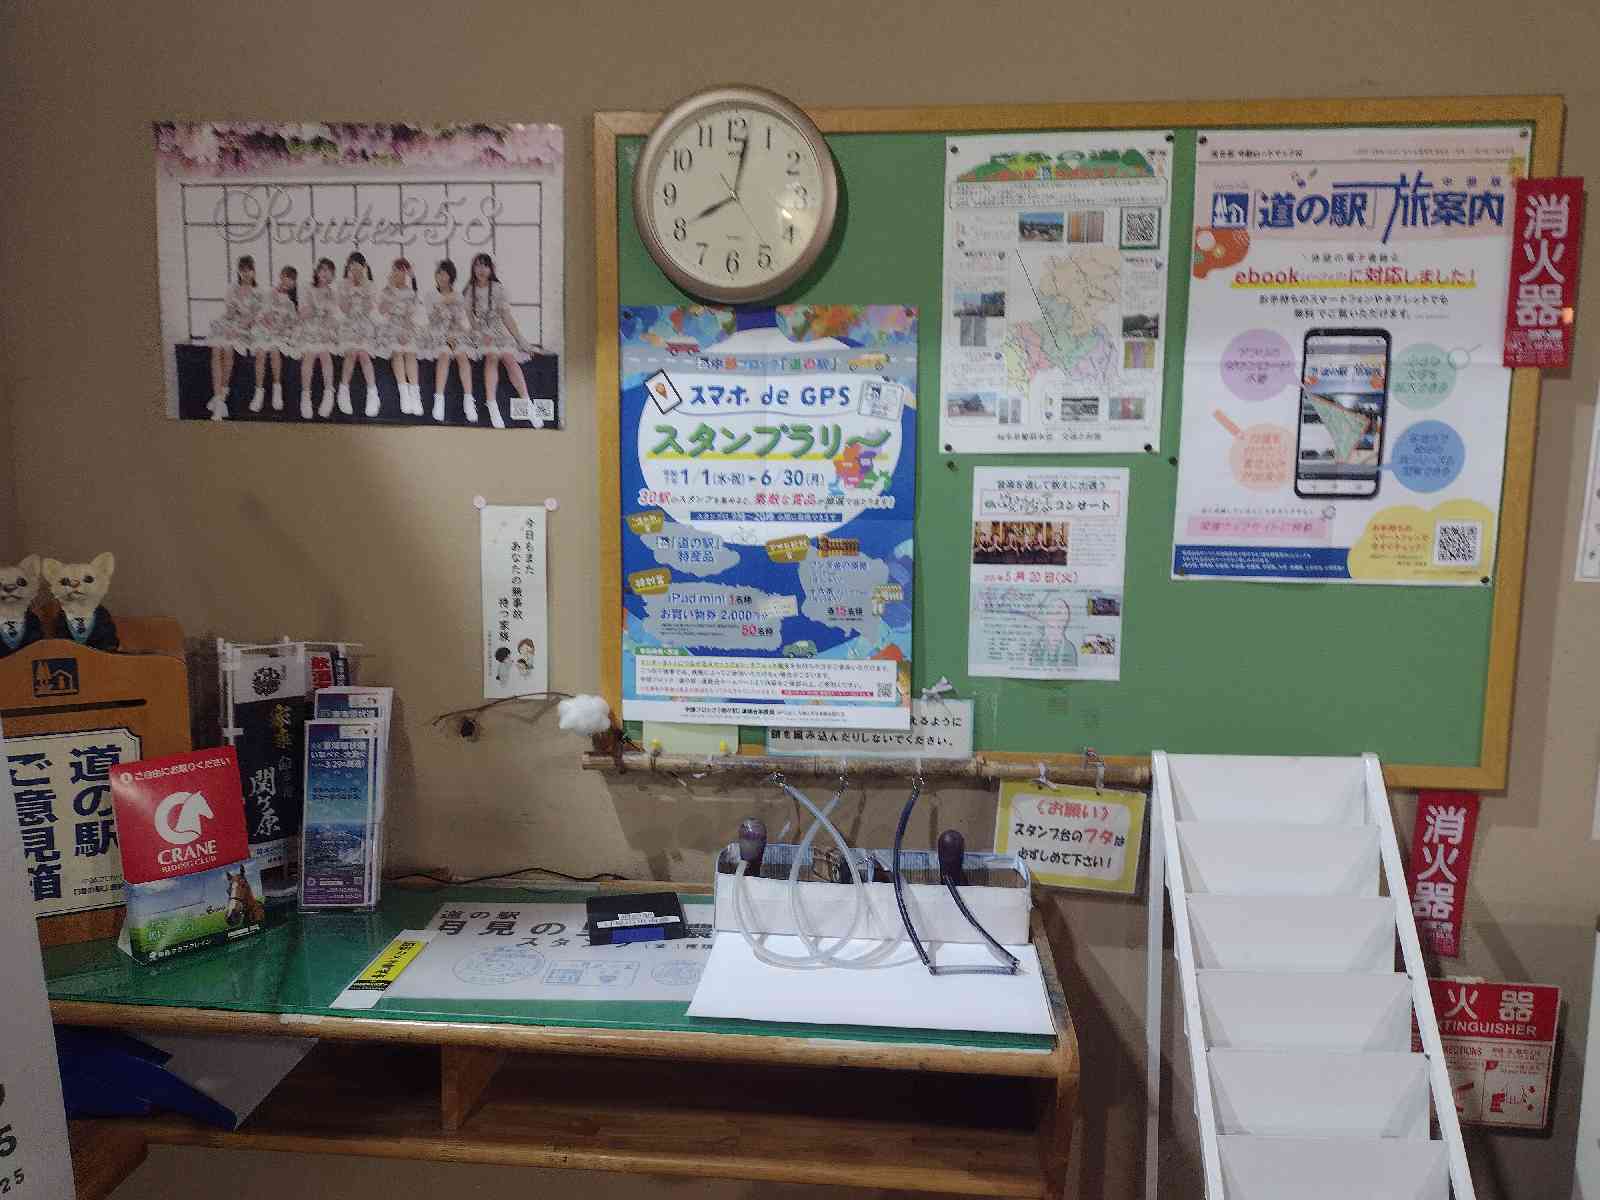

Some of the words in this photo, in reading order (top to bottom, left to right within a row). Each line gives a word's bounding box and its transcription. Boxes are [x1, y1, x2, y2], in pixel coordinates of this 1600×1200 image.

[699, 124, 712, 149] 11
[728, 117, 747, 143] 12
[766, 126, 772, 150] 1
[673, 148, 693, 173] 10
[786, 151, 801, 177] 2
[663, 182, 677, 207] 9
[1259, 191, 1369, 229] 道の駅
[673, 217, 687, 242] 8
[783, 223, 794, 245] 4
[696, 242, 709, 266] 7
[726, 249, 740, 276] 6
[758, 244, 771, 270] 5
[1516, 193, 1570, 327] 消火器
[1235, 266, 1298, 286] ebook
[690, 385, 750, 406] スマホ
[761, 384, 789, 405] de
[800, 386, 850, 406] GPS
[69, 744, 122, 857] 道の駅
[157, 839, 217, 865] CRANE
[1412, 804, 1467, 920] 消火器
[439, 910, 521, 920] 道の駅
